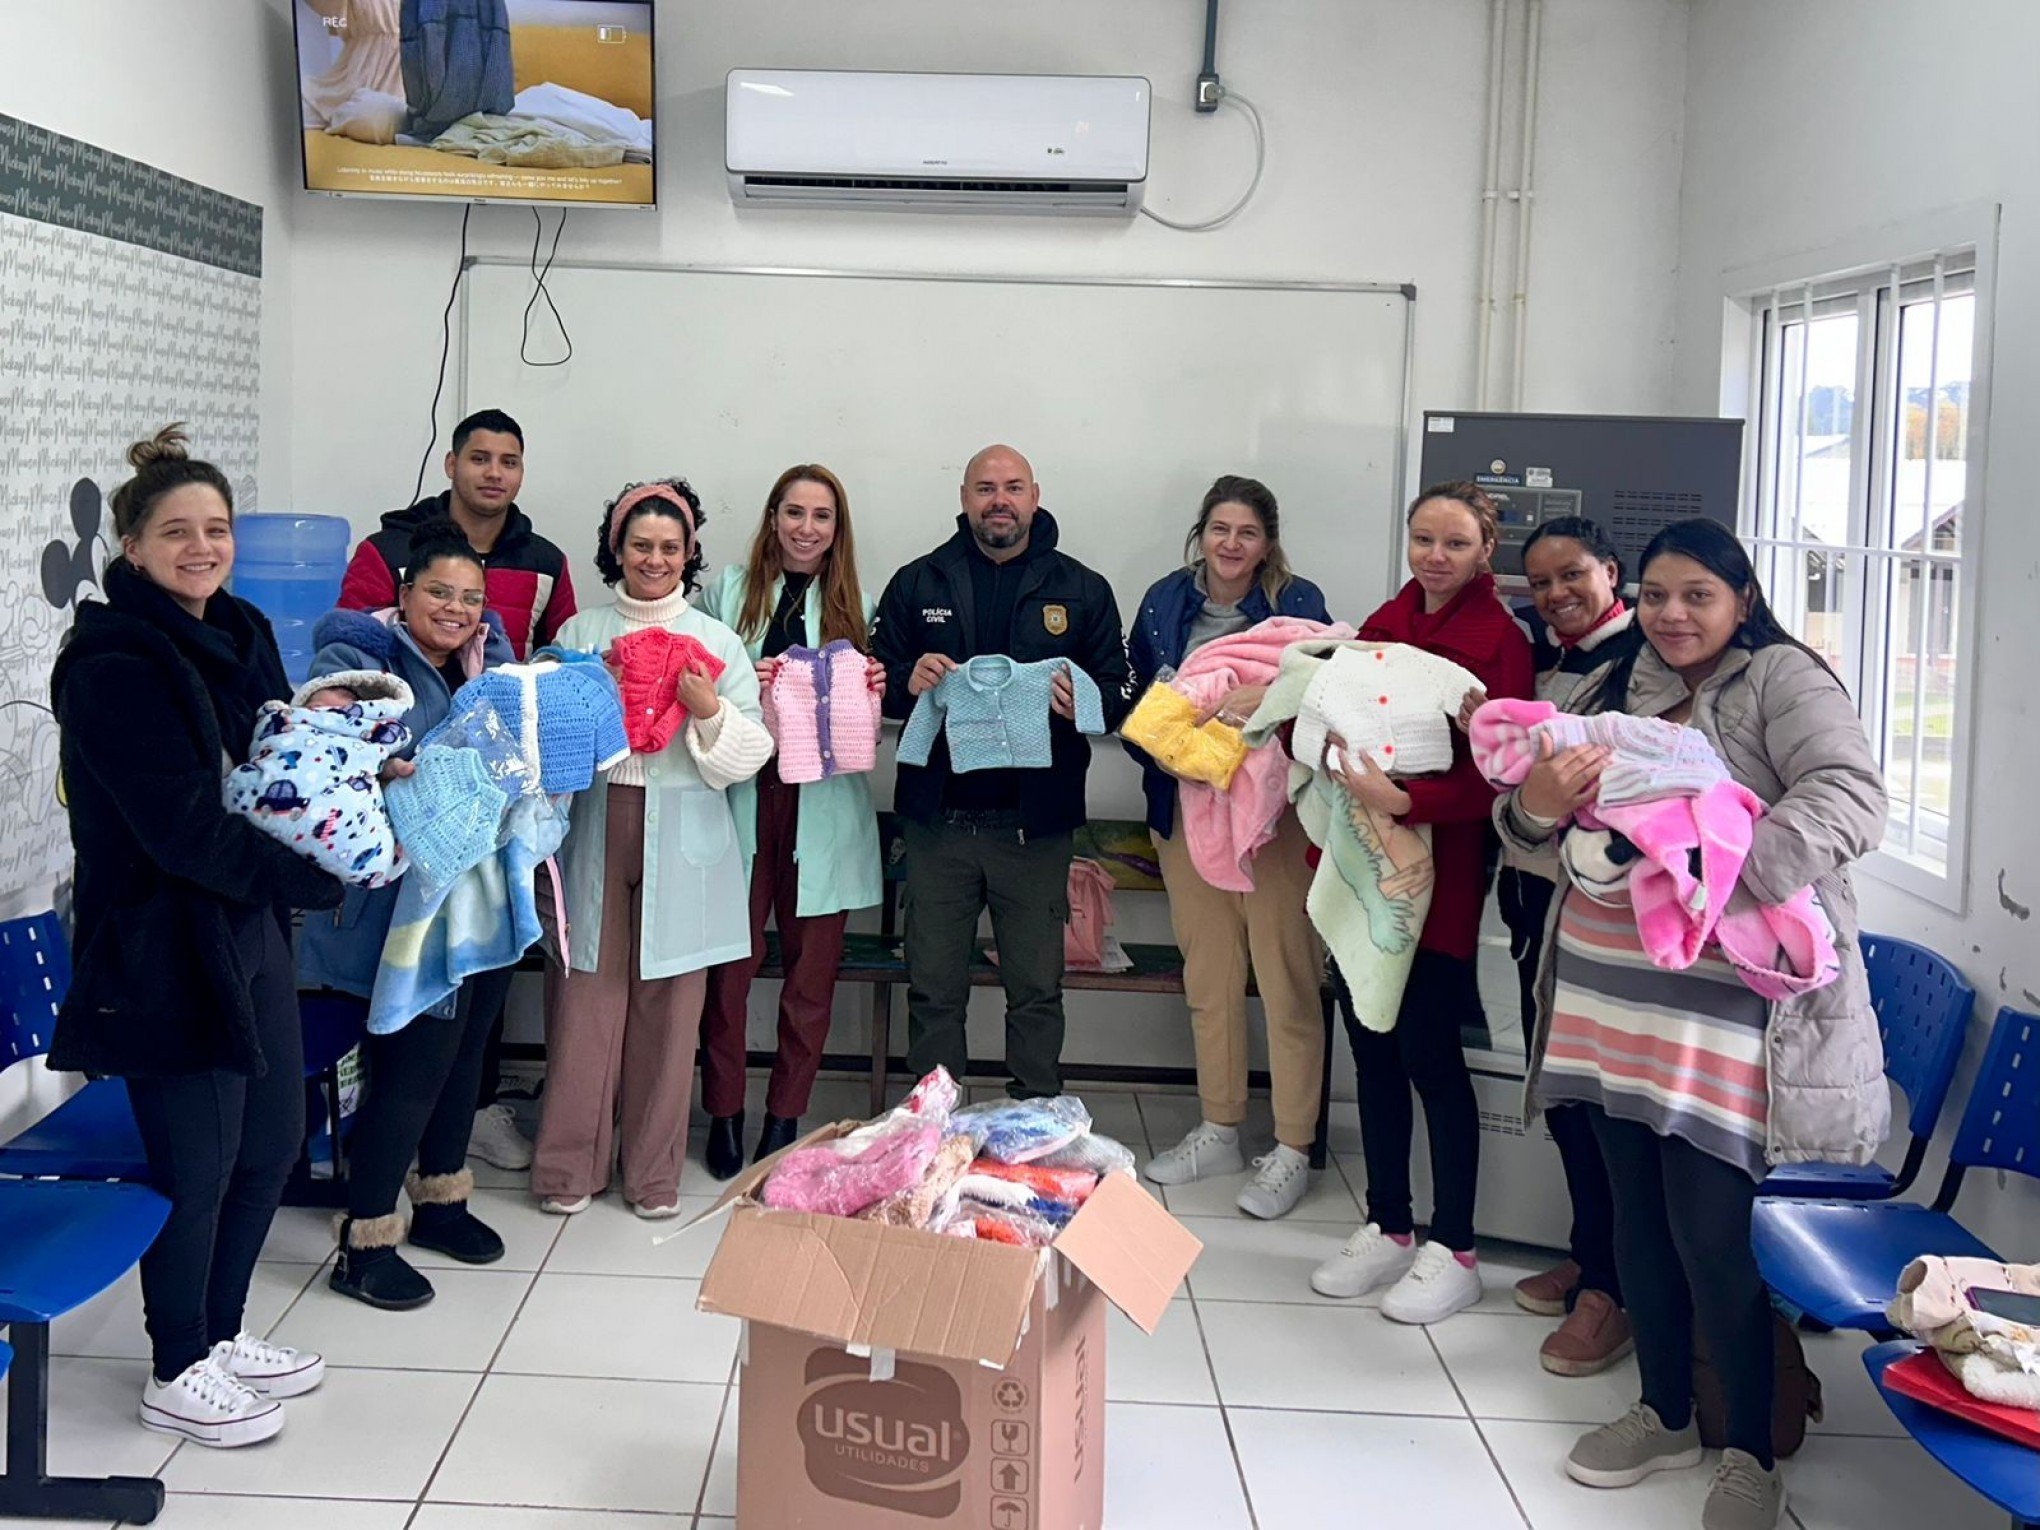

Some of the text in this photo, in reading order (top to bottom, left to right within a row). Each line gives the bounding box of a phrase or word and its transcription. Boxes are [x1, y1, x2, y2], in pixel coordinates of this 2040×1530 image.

[323, 17, 347, 28] REC
[922, 607, 952, 616] POLÍCIA
[815, 1404, 950, 1461] usual
[835, 1443, 930, 1473] UTILIDADES
